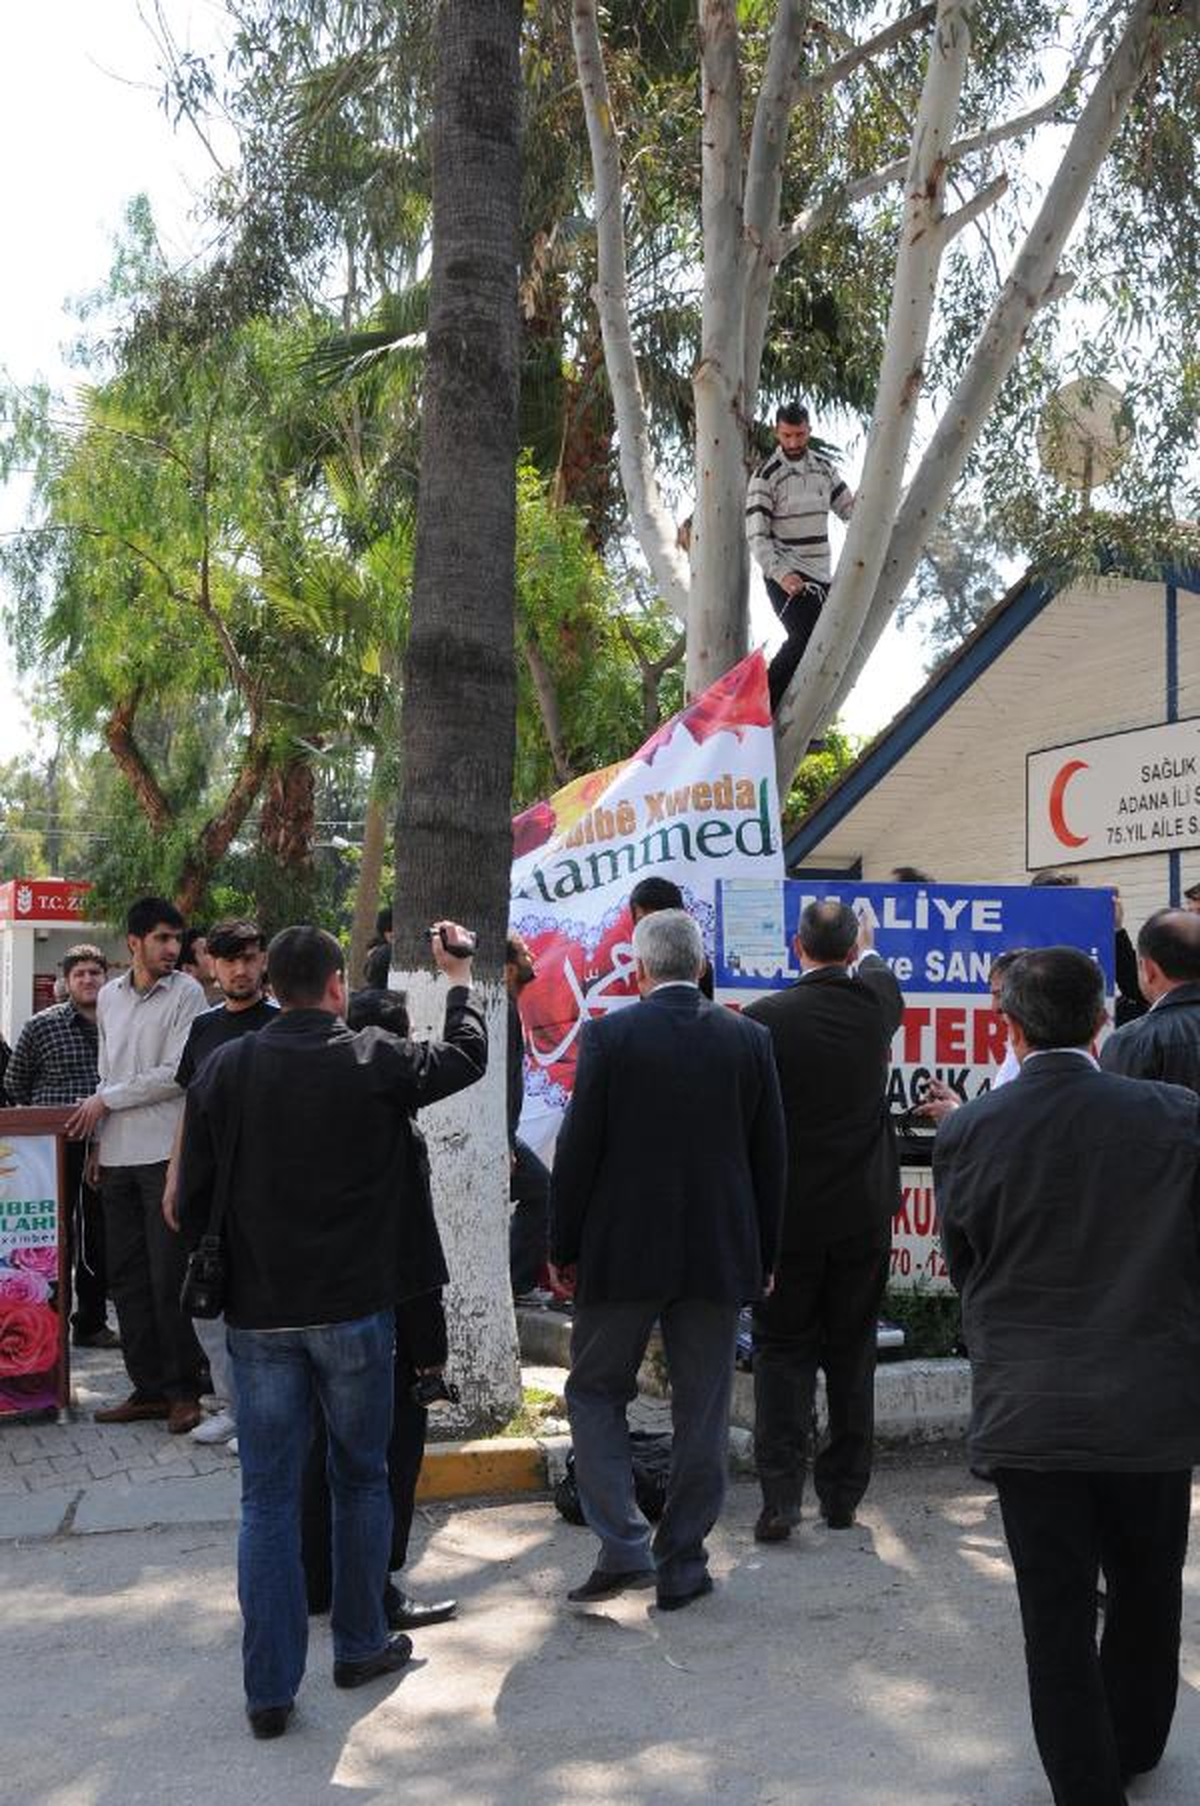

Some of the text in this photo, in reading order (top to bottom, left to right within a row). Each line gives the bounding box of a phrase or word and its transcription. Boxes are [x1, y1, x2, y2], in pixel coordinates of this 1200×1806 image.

[1141, 757, 1197, 783] SAĞLIK
[1118, 791, 1169, 815] ADANA
[1151, 815, 1184, 839] AİLE
[801, 889, 1003, 932] ALİYE
[925, 950, 1004, 983] SAN
[0, 1200, 56, 1216] BER
